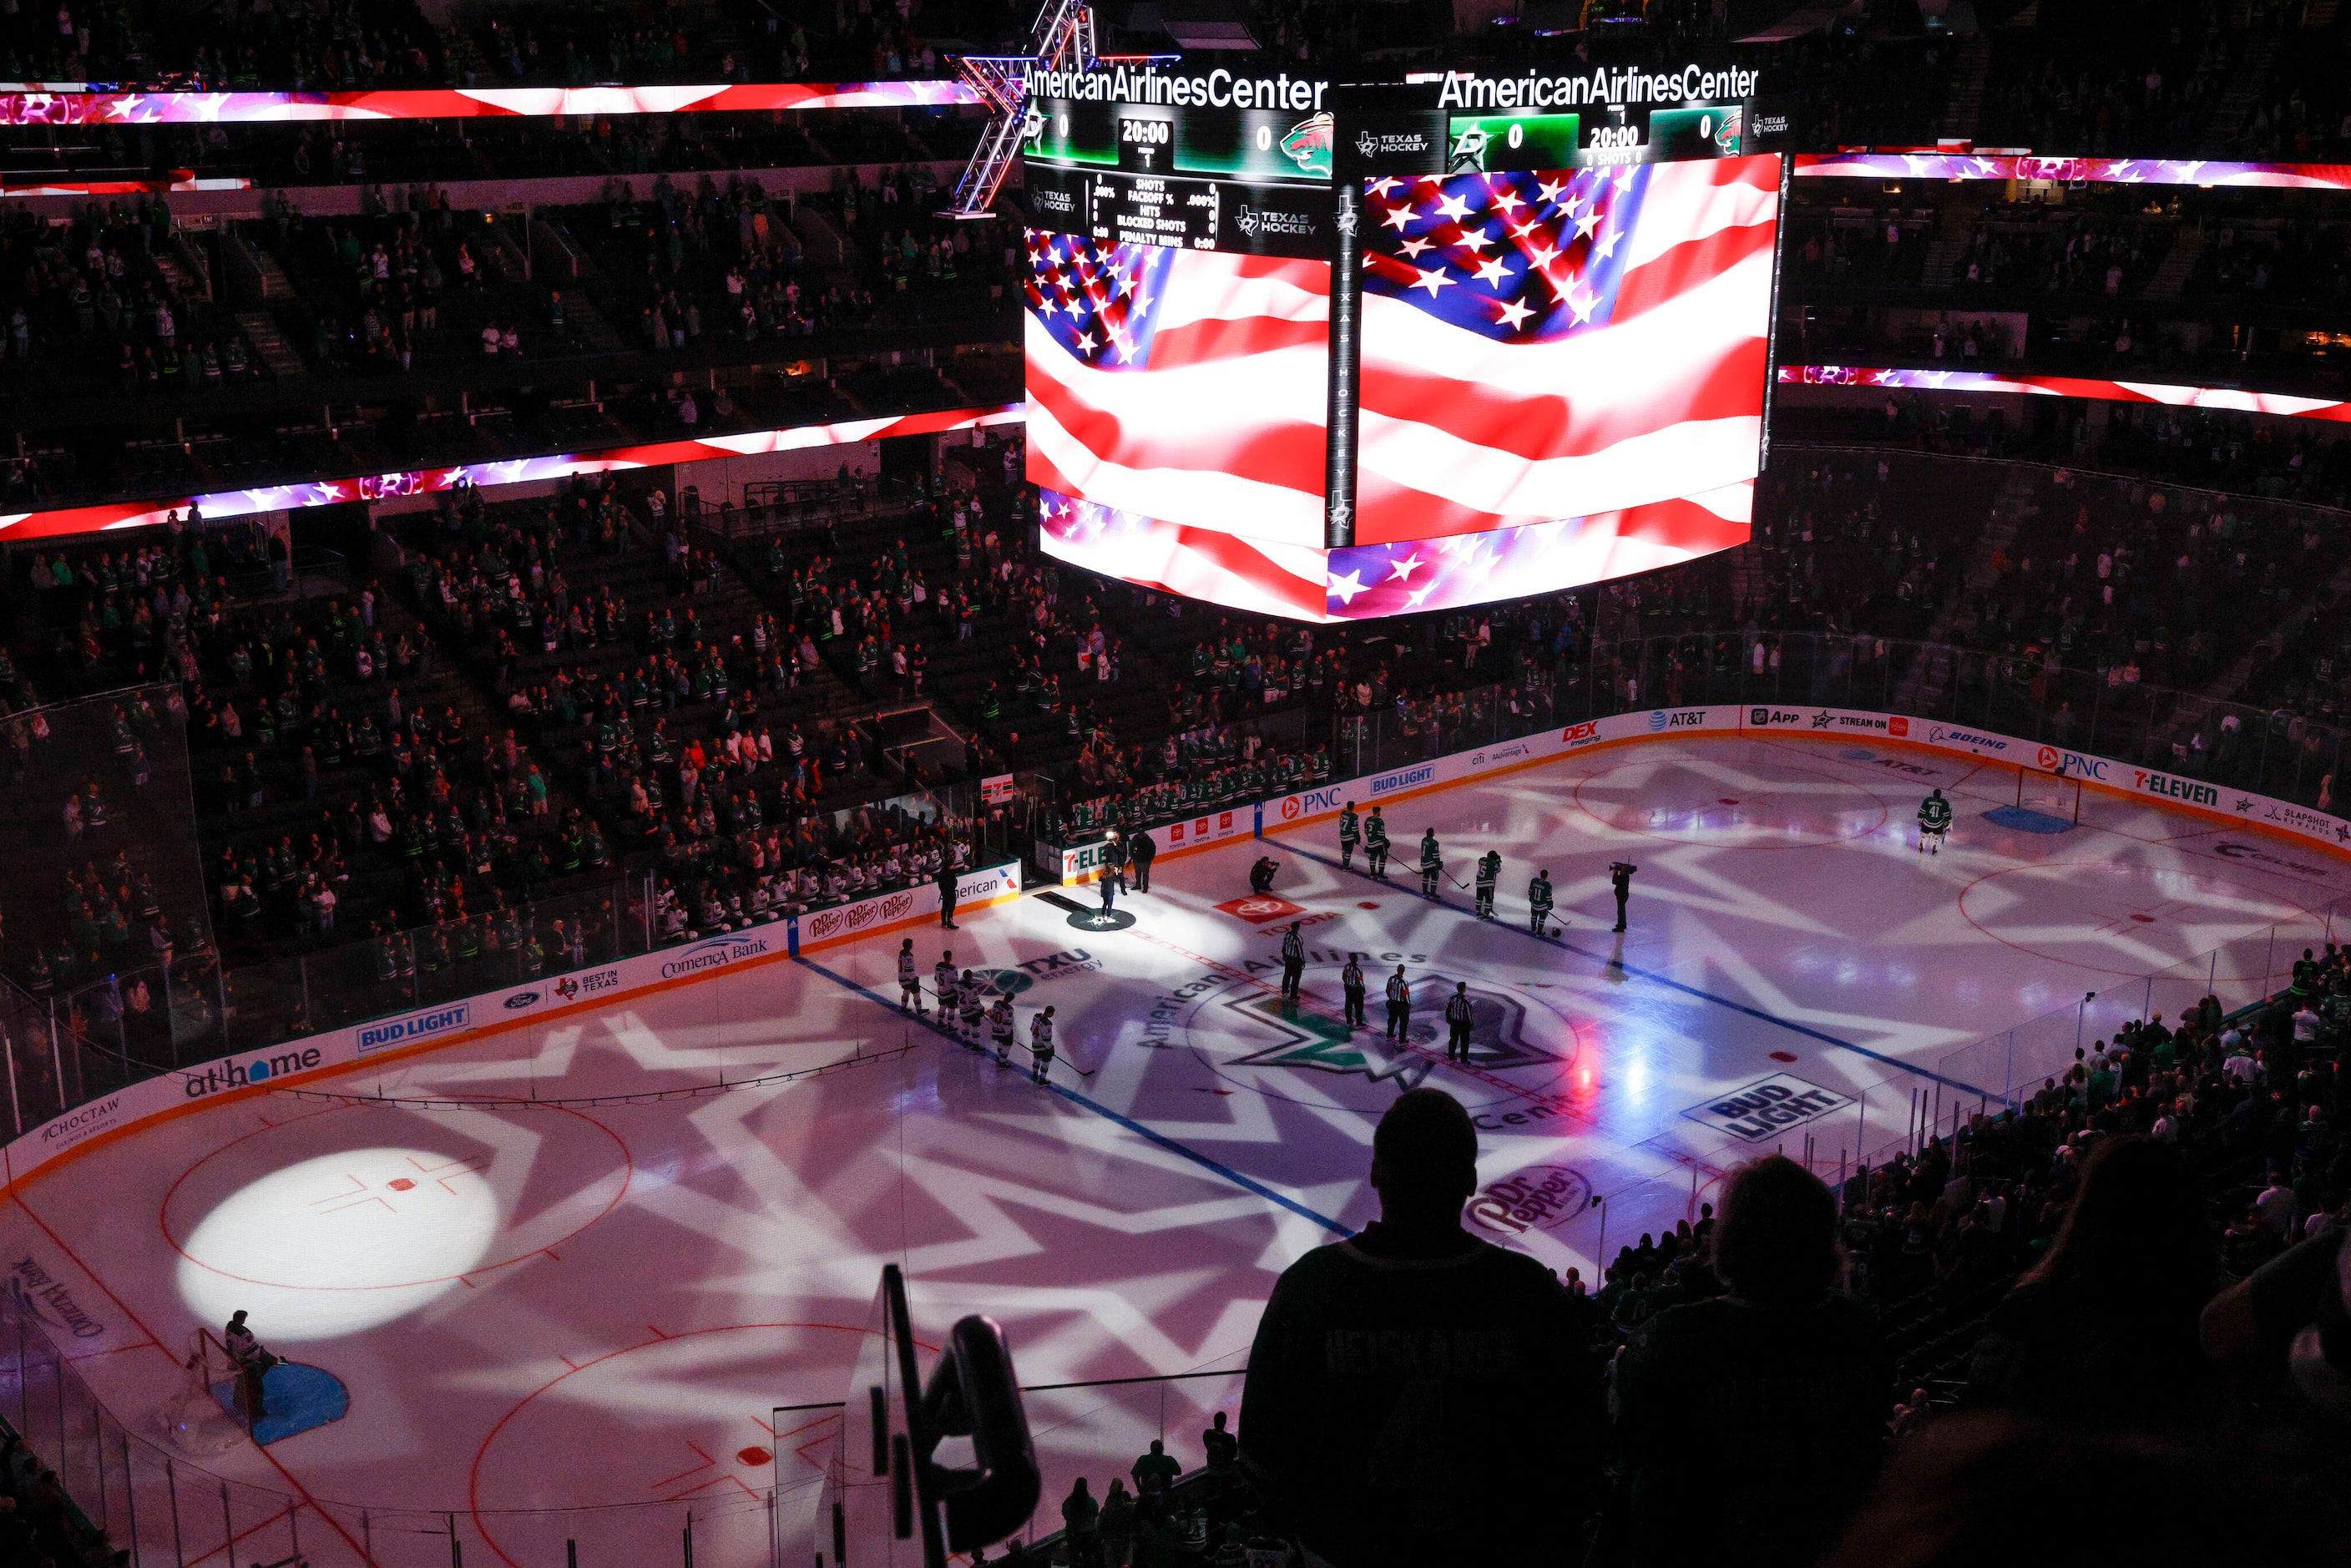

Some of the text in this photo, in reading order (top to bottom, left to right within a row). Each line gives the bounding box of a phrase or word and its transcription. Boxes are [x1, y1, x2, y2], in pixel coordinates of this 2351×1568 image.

[1025, 62, 1327, 110] AmericanAirlinesCenter
[1438, 63, 1758, 109] AmericanAirlinesCenter
[1059, 114, 1069, 138] 0
[1620, 112, 1625, 125] 1
[1700, 115, 1711, 139] 0
[1763, 116, 1785, 125] TEXAS
[1763, 123, 1788, 134] HOCKEY
[1123, 120, 1169, 144] 20:00
[1256, 125, 1271, 151] 0
[1380, 134, 1421, 144] TEXAS
[1508, 124, 1523, 149] 0
[1590, 126, 1640, 148] 20:00
[1380, 142, 1428, 153] HOCKEY
[1145, 154, 1150, 168] 1
[1587, 153, 1593, 166] 0
[1598, 152, 1631, 165] SHOTS
[1135, 178, 1165, 192] SHOTS
[1044, 190, 1070, 203] TEXAS
[1127, 190, 1162, 205] FACEOFF
[1165, 194, 1174, 205] %
[1044, 200, 1075, 214] HOCKEY
[1140, 205, 1160, 218] HITS
[1117, 215, 1153, 231] BLOCKED
[1155, 219, 1186, 234] SHOTS
[1261, 211, 1308, 225] TEXAS
[1261, 222, 1317, 236] HOCKEY
[1119, 230, 1155, 246] PENALTY
[1158, 233, 1183, 249] MINS
[1339, 251, 1350, 342] TEXAS
[1337, 369, 1348, 477] HOCKEY
[1670, 712, 1706, 726] AT&T
[1839, 716, 1887, 729] STREAM ON
[1562, 721, 1598, 742] DEX
[1949, 731, 2007, 750] BOEING
[1472, 753, 1484, 765] citi
[2062, 753, 2108, 780] PNC
[1373, 767, 1432, 792] BUD LIGHT
[1302, 787, 1341, 812] PNC
[1929, 805, 1940, 818] 41
[2284, 808, 2330, 828] SLAPSHOT
[856, 903, 867, 914] Dr
[880, 896, 910, 919] Pepper
[892, 895, 902, 905] Dr
[810, 914, 841, 937] Pepper
[821, 913, 832, 923] Dr
[845, 906, 876, 928] Pepper
[732, 939, 768, 959] Bank
[1016, 948, 1091, 974] TXU
[1041, 959, 1102, 980] energy
[583, 969, 617, 984] BEST IN
[583, 977, 618, 992] TEXAS
[1136, 950, 1428, 1050] American Ailines
[362, 1008, 465, 1047] BUD LIGHT
[1709, 1085, 1794, 1120] BUD
[48, 1098, 119, 1138] CHOCTAW
[1725, 1090, 1838, 1138] LIGHT
[1484, 1176, 1534, 1206] Dr
[1467, 1171, 1571, 1233] Pepper
